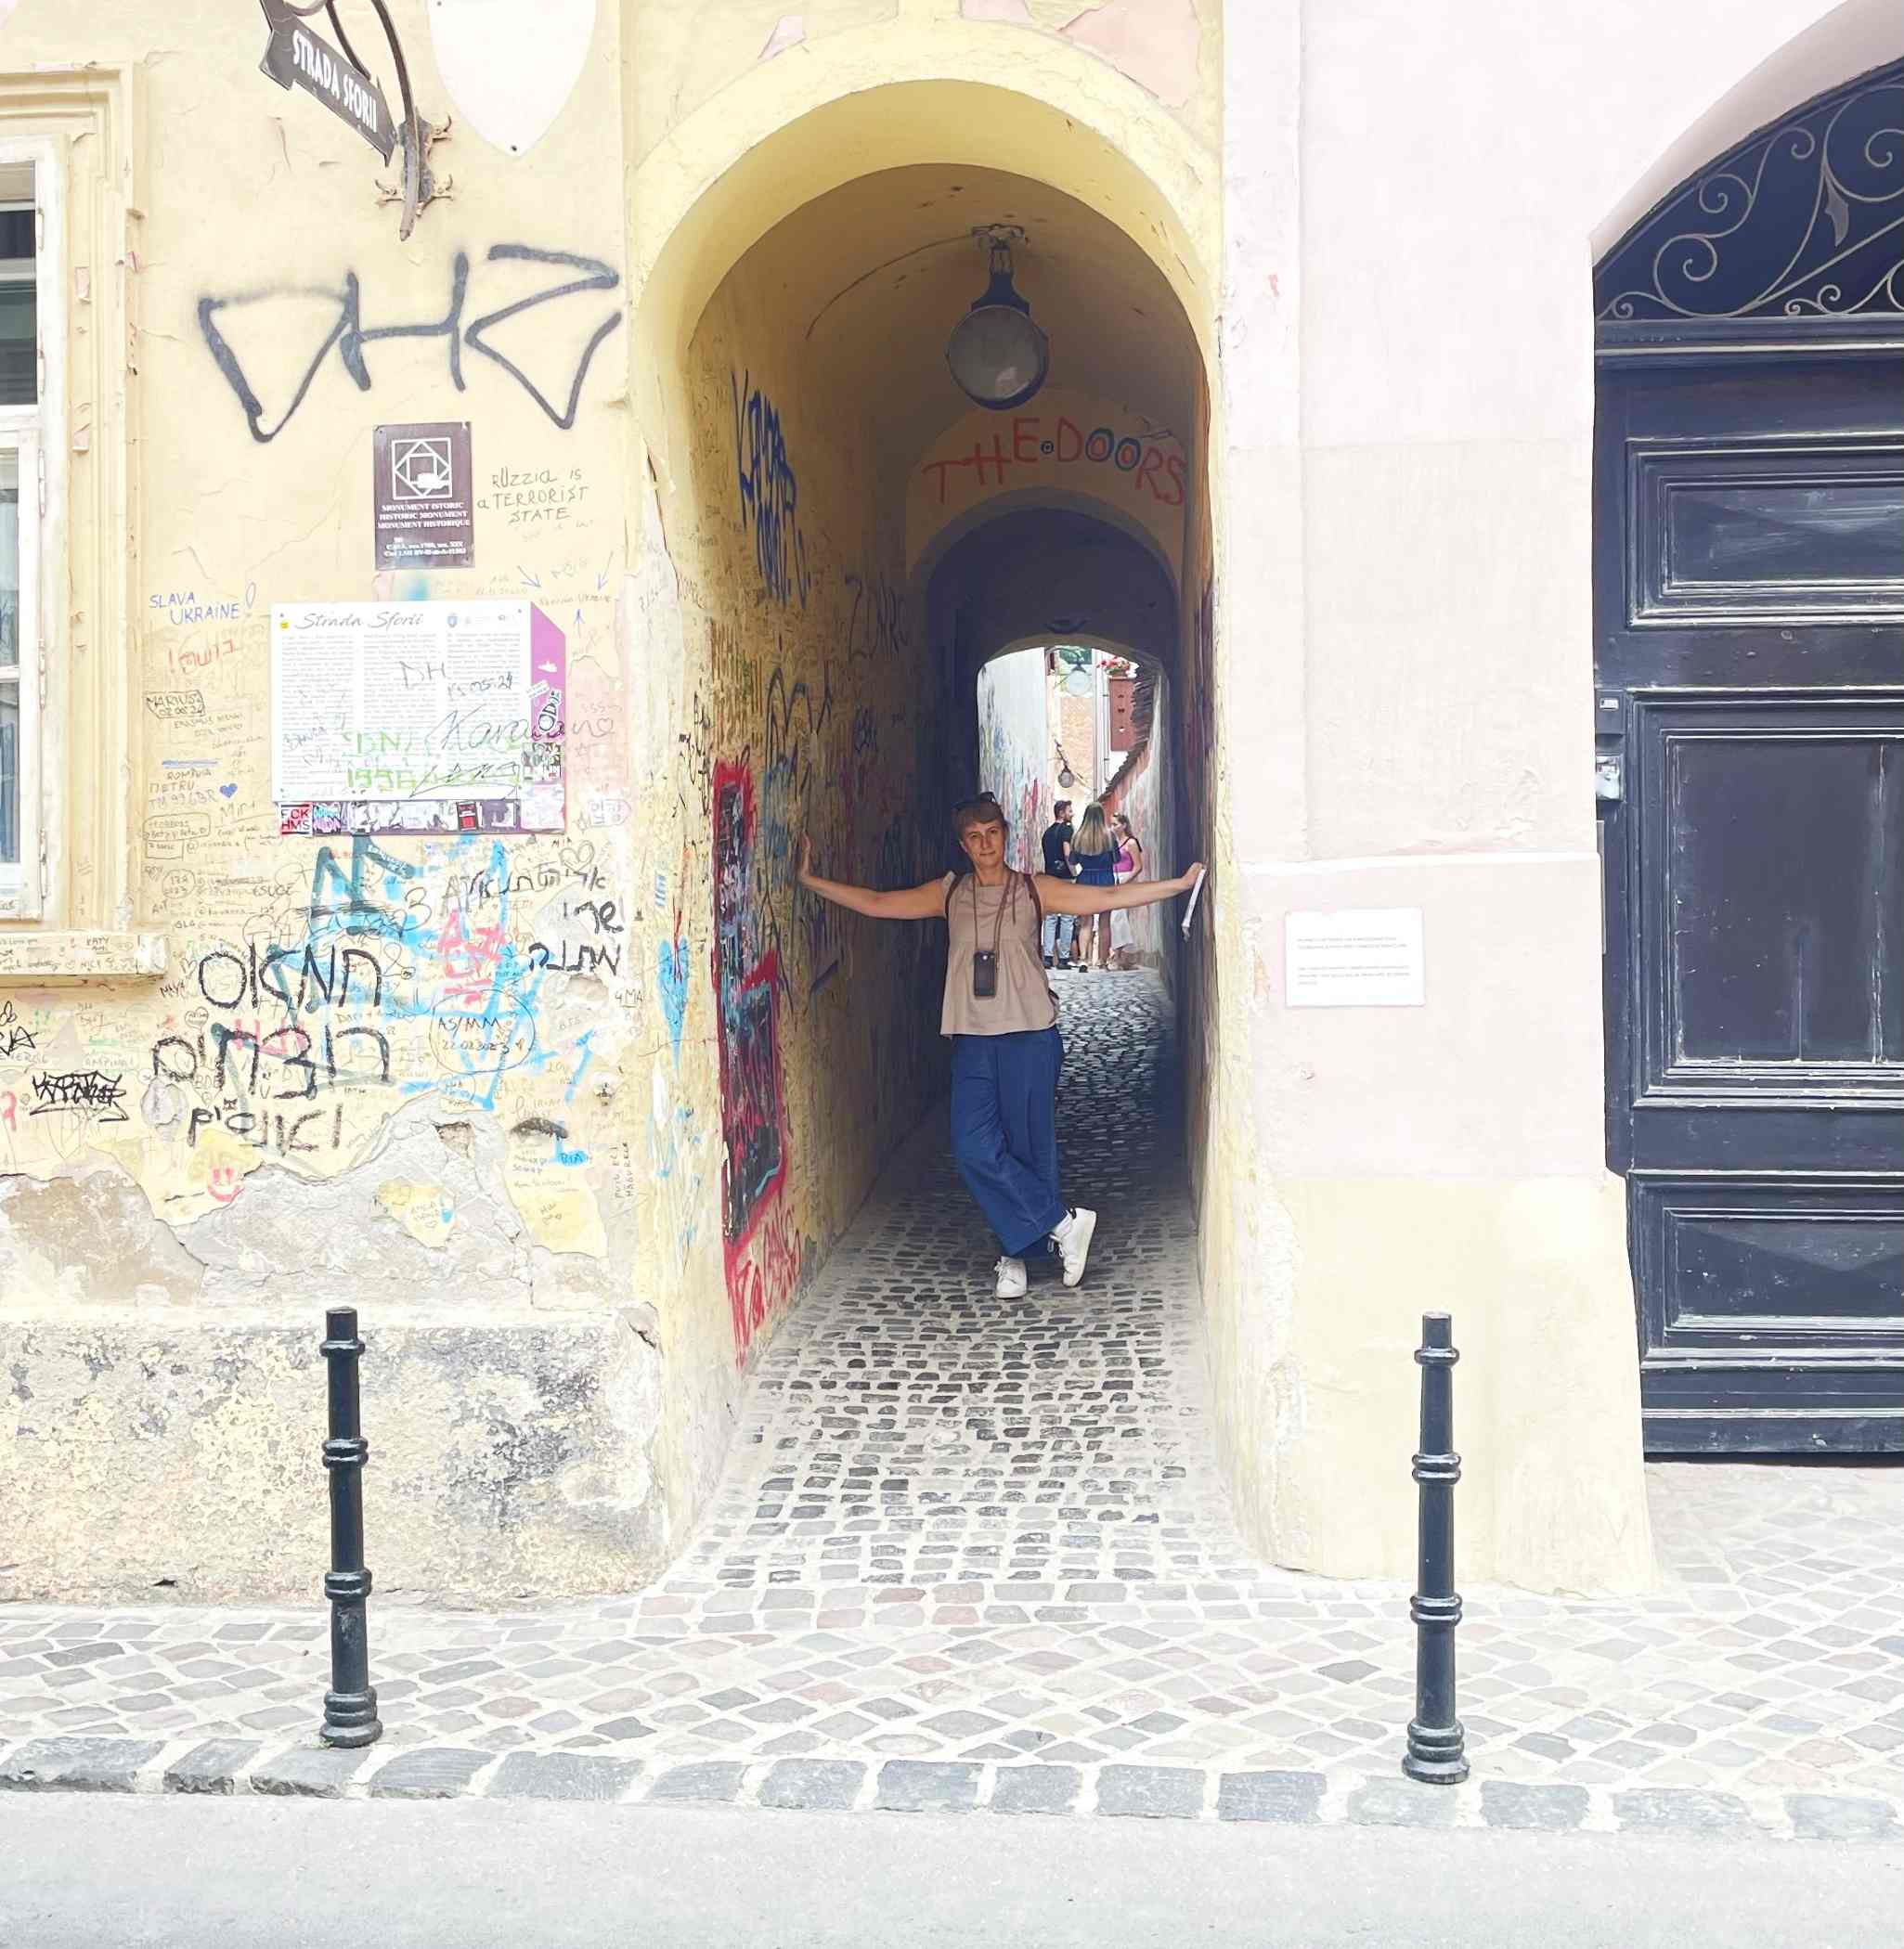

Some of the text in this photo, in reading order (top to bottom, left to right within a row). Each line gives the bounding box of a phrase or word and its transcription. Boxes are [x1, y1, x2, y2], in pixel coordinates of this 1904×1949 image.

[291, 30, 378, 135] STRADA SFORII
[922, 418, 1188, 505] THE DOORS
[382, 503, 429, 511] MONUMENT
[379, 510, 468, 521] HISTORIC MONUMENT
[509, 507, 571, 523] STATE
[377, 521, 422, 529] MONUMENT
[149, 592, 195, 609] SLAVA
[294, 611, 424, 631] Strada Sforii
[280, 809, 310, 820] FCK
[280, 820, 310, 831] HMS
